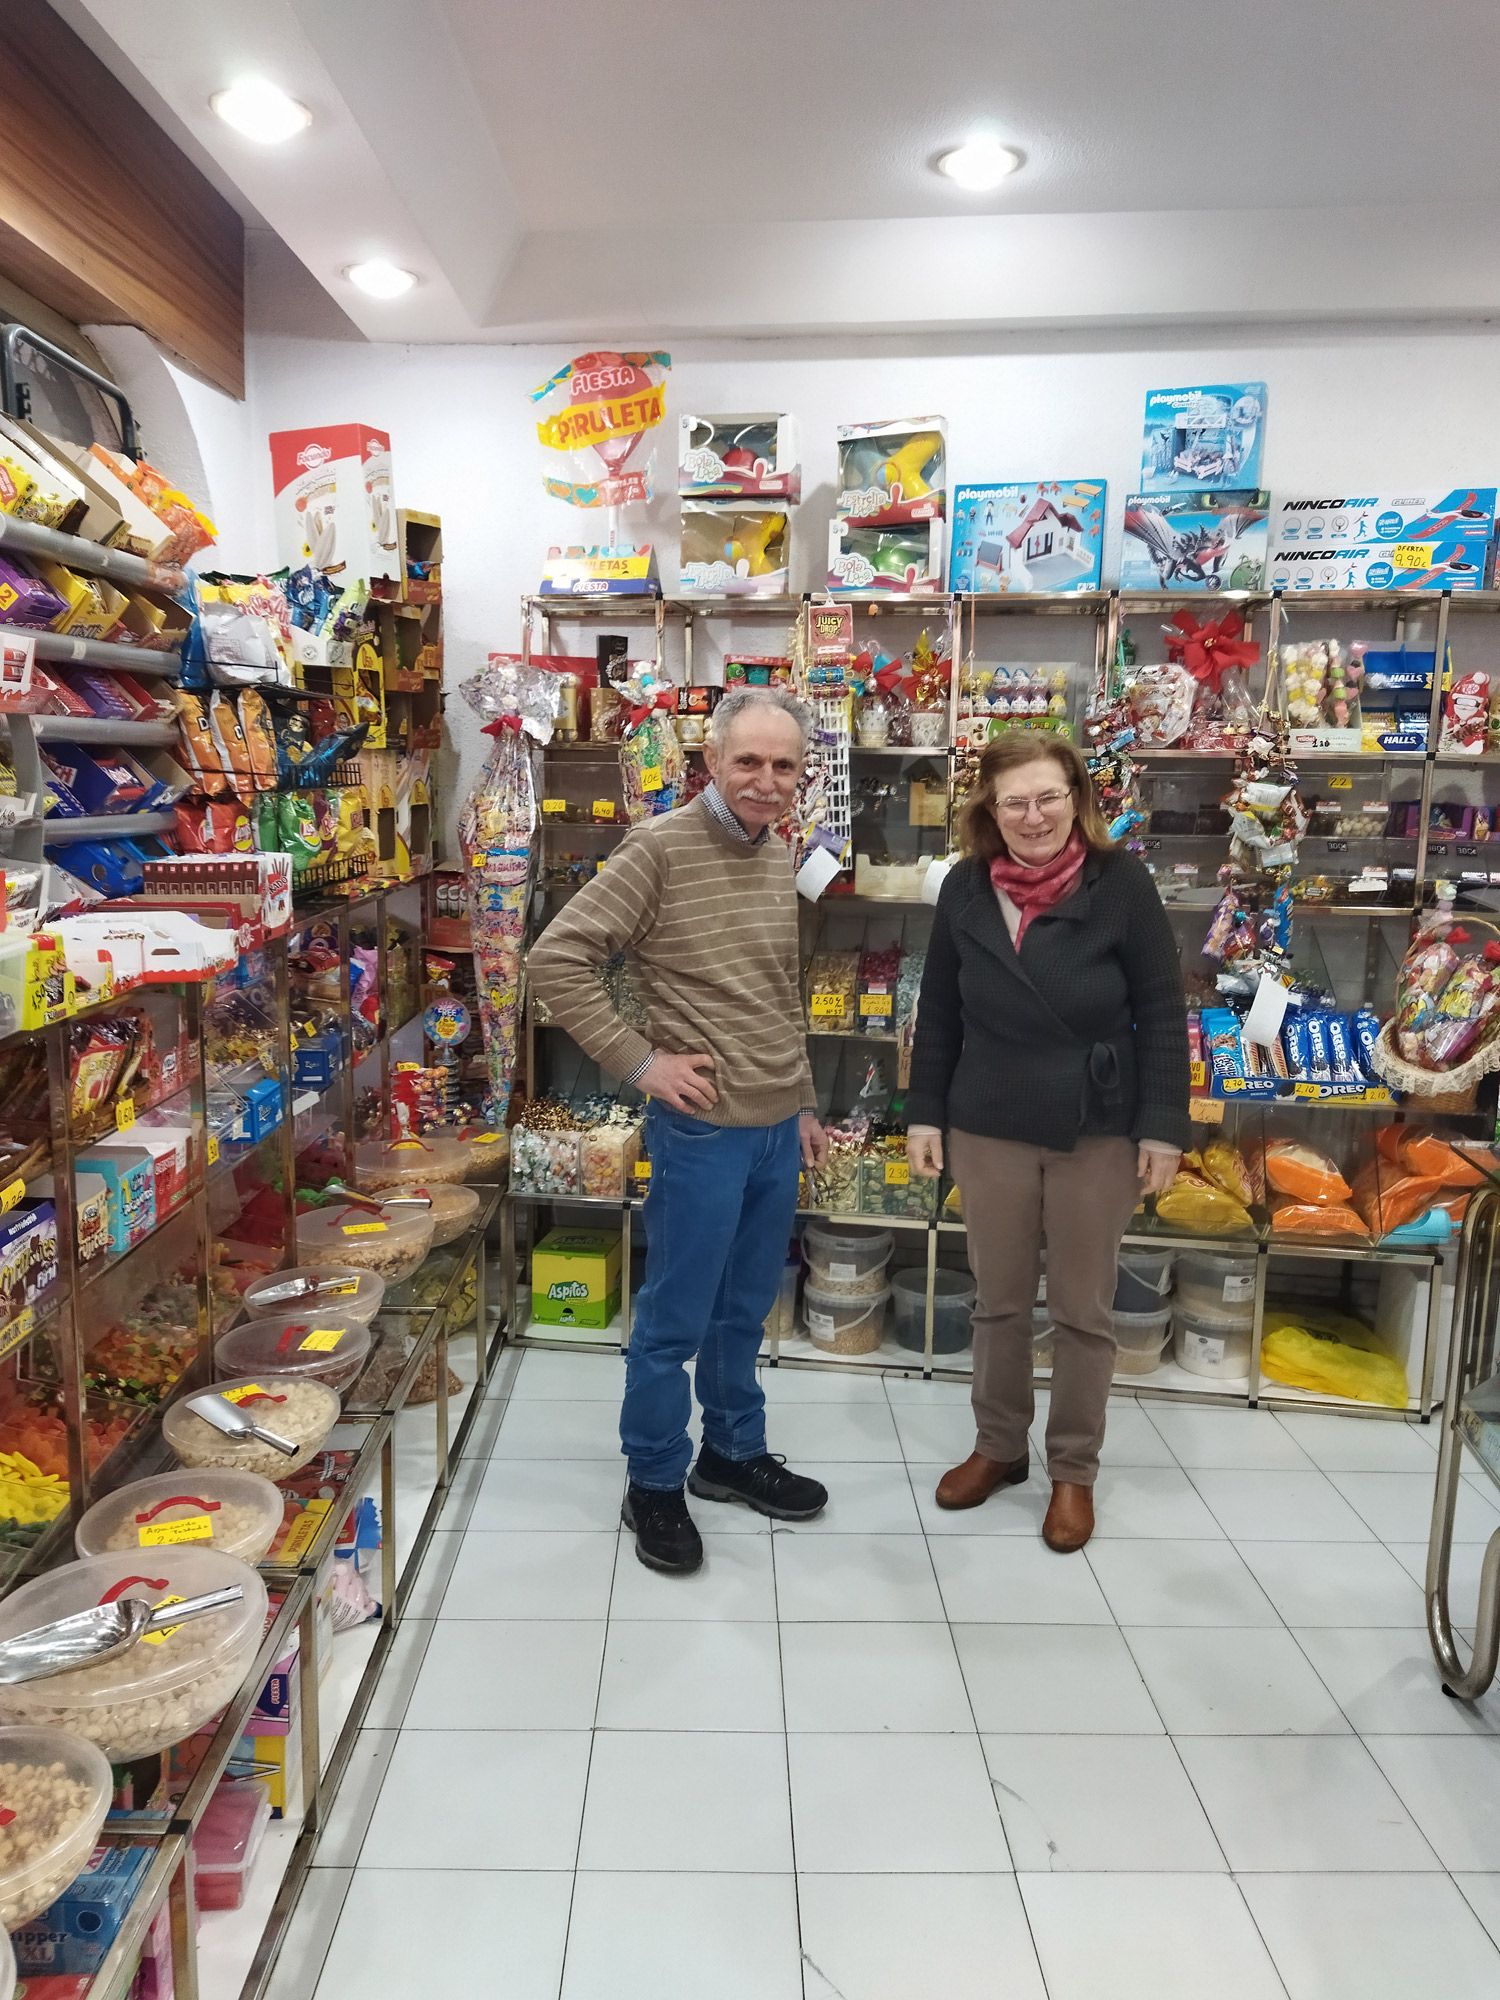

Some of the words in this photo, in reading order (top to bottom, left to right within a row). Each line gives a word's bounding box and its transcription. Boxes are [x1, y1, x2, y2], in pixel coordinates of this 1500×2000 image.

[571, 366, 635, 395] FIESTA
[1150, 390, 1202, 407] playmobil
[958, 486, 1019, 502] playmobil
[1127, 495, 1171, 507] playmobil
[1283, 497, 1379, 511] NINCOAIR
[1273, 549, 1370, 562] NINCOAIR
[573, 581, 609, 592] FIESTA
[816, 616, 843, 628] JUICY
[821, 625, 838, 633] DROP
[1390, 674, 1423, 682] HALLS
[1383, 736, 1416, 744] HALLS
[1286, 1024, 1300, 1062] OREO
[1308, 1020, 1325, 1059] OREO
[1330, 1021, 1346, 1060] OREO
[548, 1281, 588, 1300] Aspitos
[288, 1519, 314, 1553] PIRULETAS
[270, 1679, 280, 1705] FIESTA
